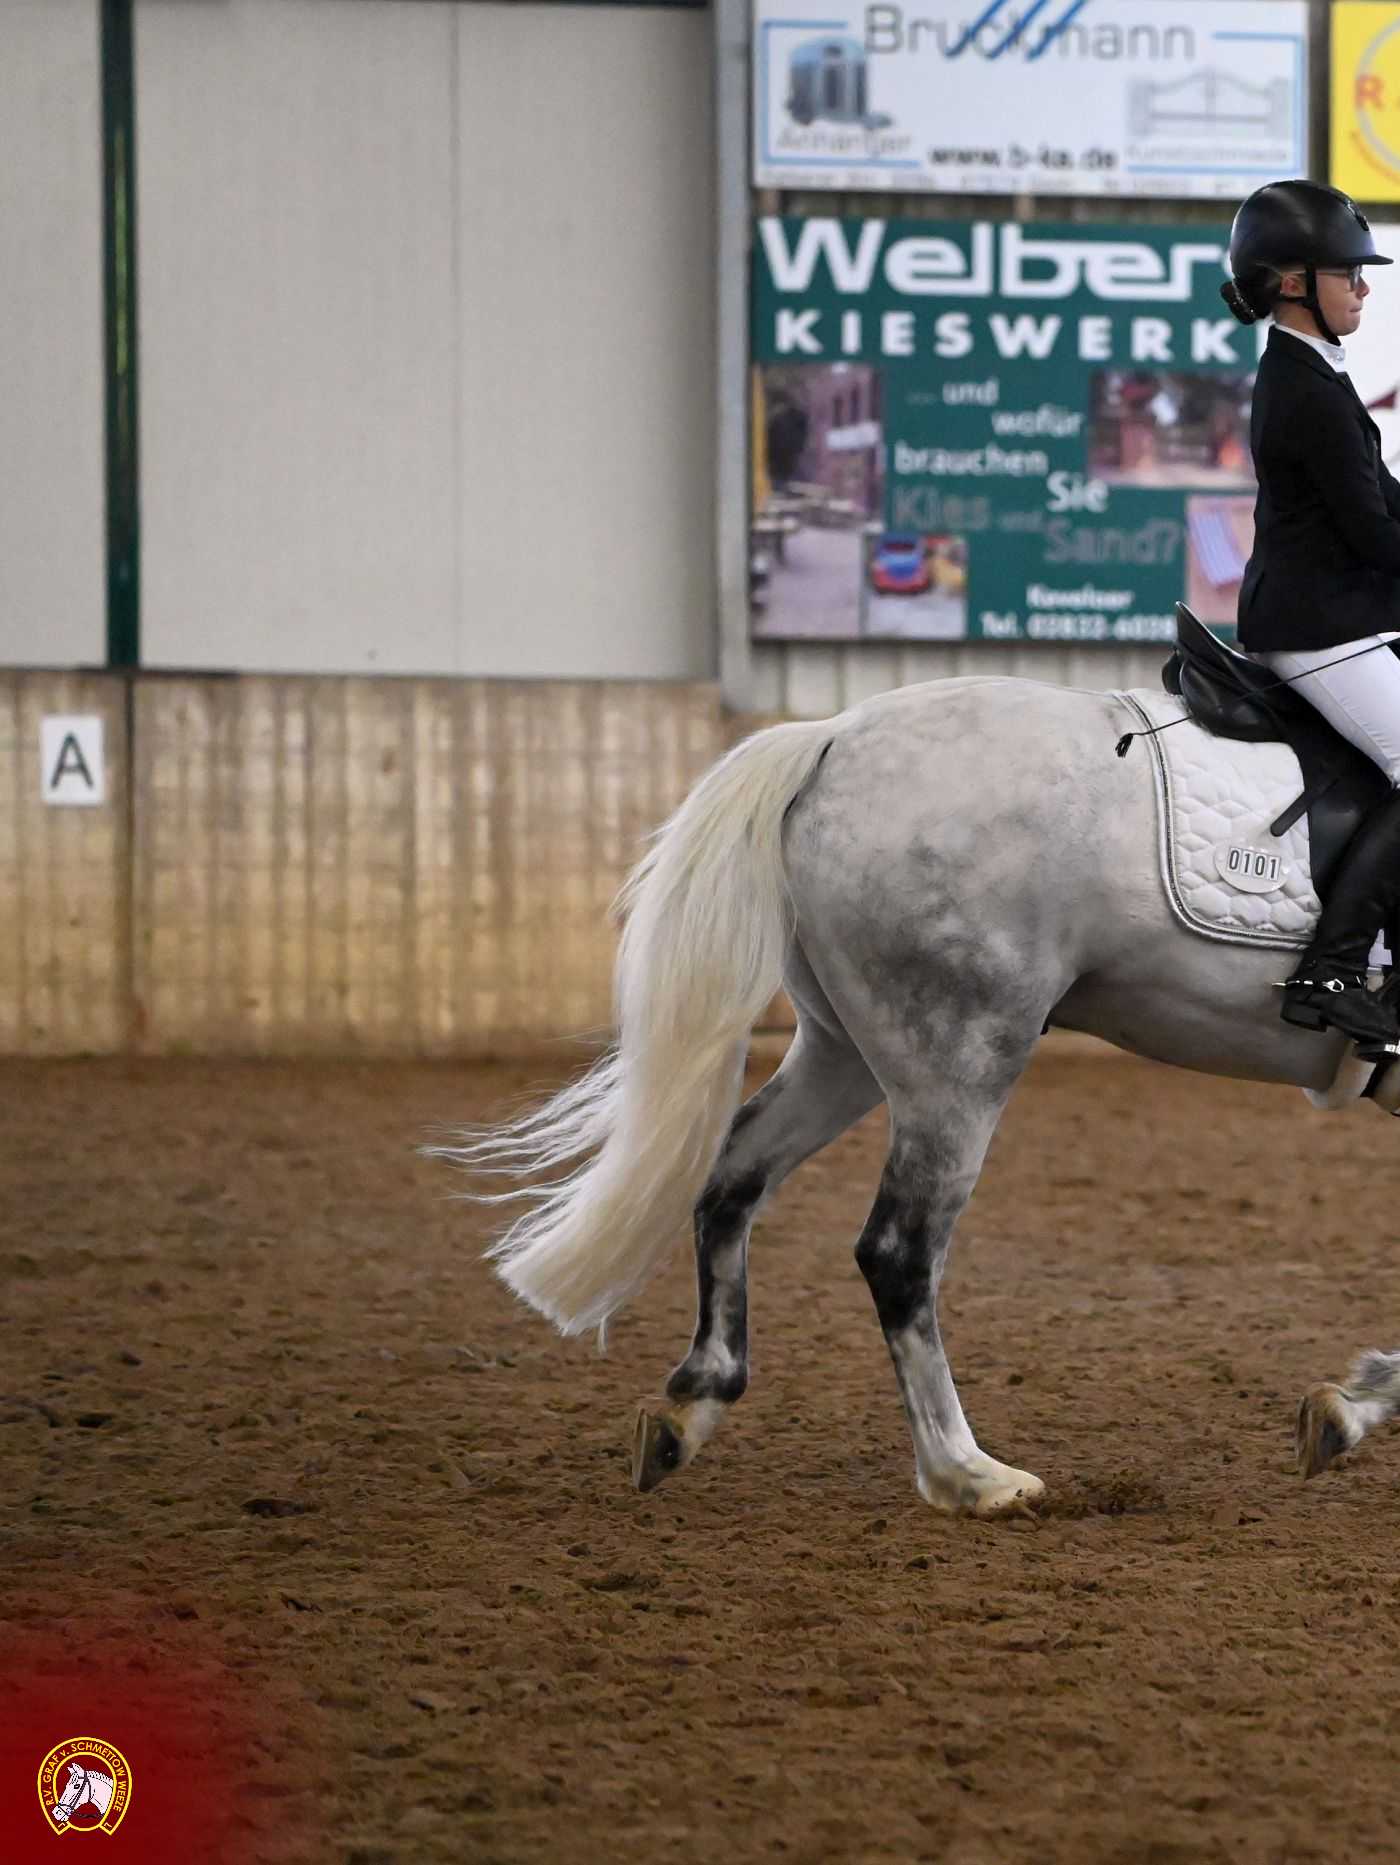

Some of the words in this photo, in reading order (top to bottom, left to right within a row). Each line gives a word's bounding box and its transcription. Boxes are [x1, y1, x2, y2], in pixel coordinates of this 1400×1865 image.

[942, 377, 999, 406] und
[992, 402, 1083, 438] wofür
[894, 440, 1049, 475] brauchen
[1046, 469, 1109, 514] Sie
[1044, 517, 1182, 565] Sand?
[51, 732, 95, 789] A
[1228, 849, 1278, 879] 0101
